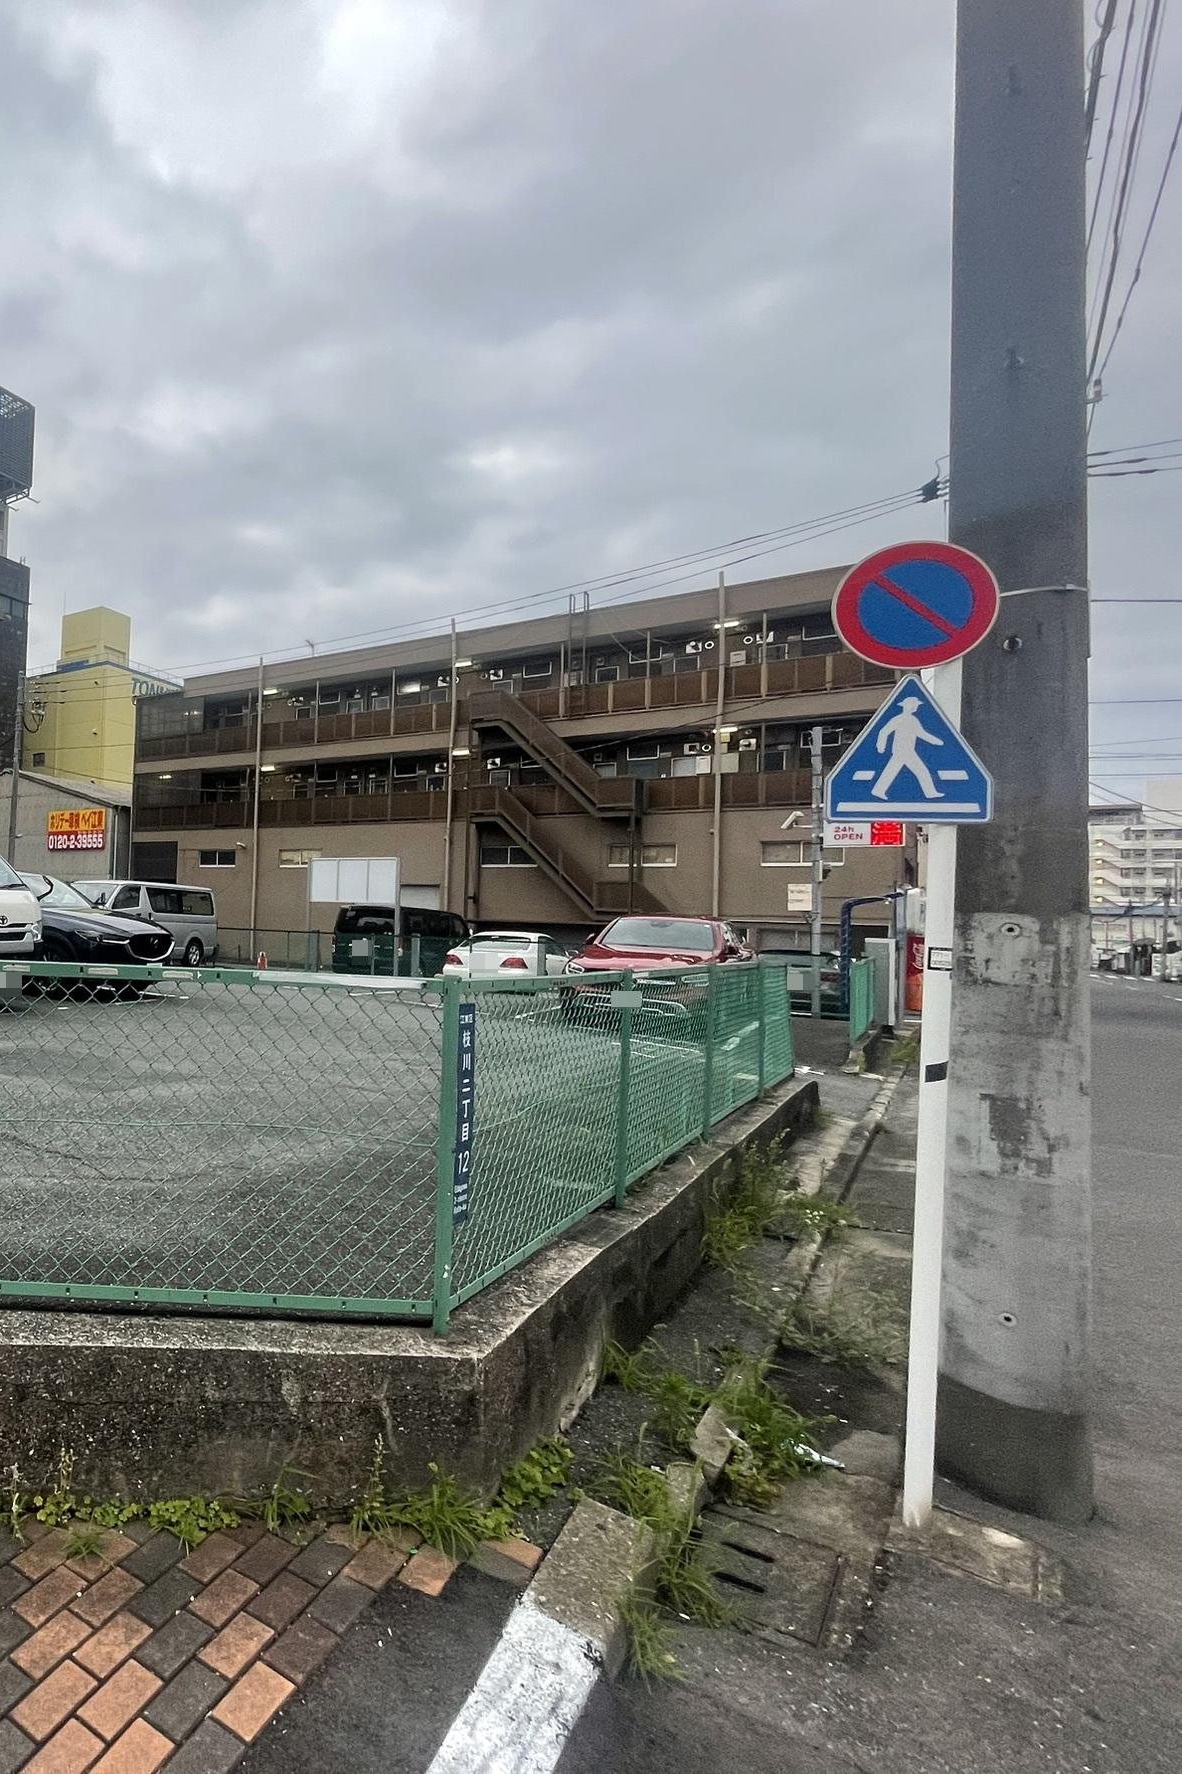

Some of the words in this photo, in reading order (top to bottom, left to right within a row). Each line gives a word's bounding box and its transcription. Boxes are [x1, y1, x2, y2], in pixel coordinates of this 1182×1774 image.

[48, 833, 104, 849] 0120-2-39555
[833, 833, 864, 841] OPEN
[461, 1030, 471, 1142] 枝川二丁目
[458, 1150, 470, 1175] 12
